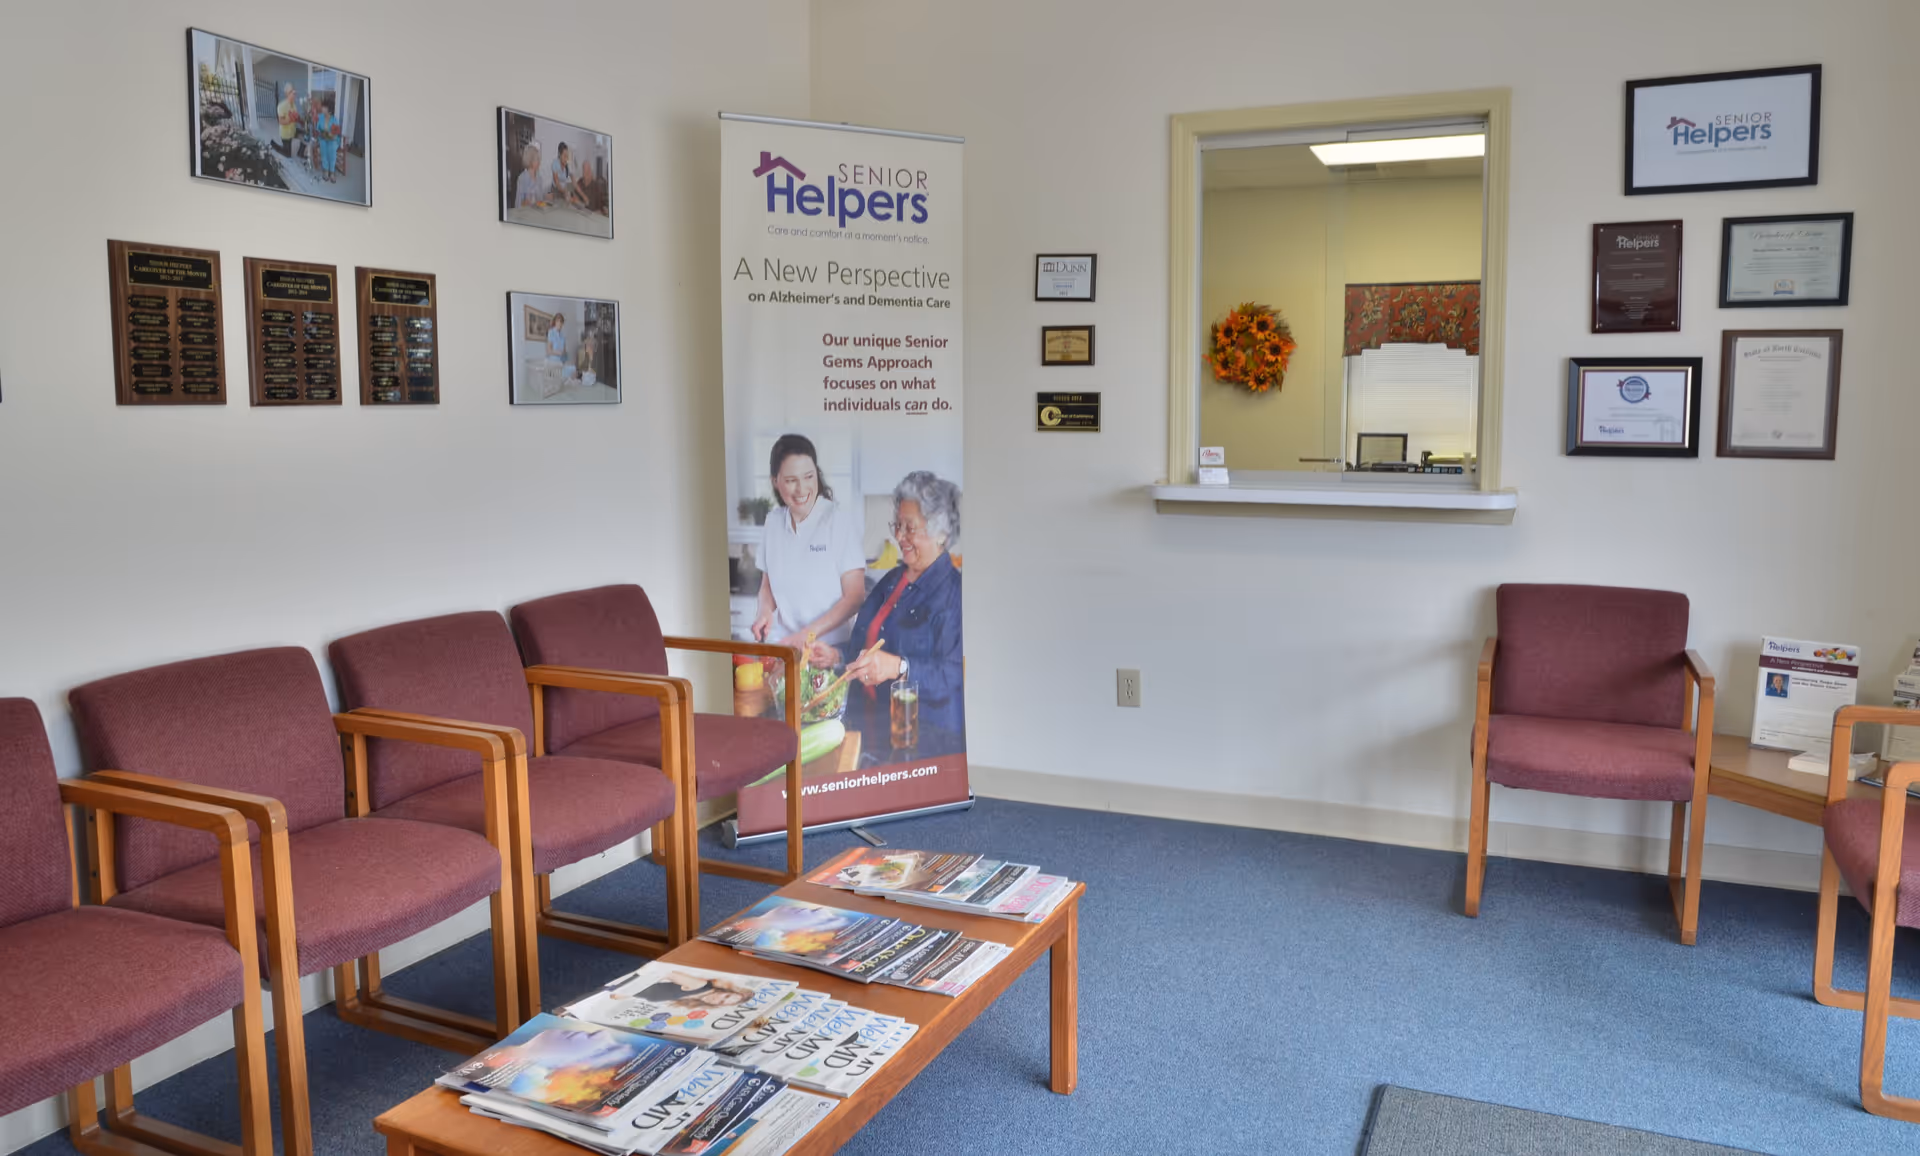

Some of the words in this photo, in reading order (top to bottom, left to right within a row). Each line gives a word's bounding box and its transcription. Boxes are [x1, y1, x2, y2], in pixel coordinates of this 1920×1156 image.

[1715, 112, 1772, 126] SENIOR
[1673, 122, 1772, 148] Helpers
[838, 163, 928, 190] SENIOR
[766, 172, 929, 228] Helpers
[767, 225, 789, 236] Care
[790, 226, 808, 237] and
[810, 228, 842, 239] comfort
[844, 231, 853, 239] at
[854, 232, 861, 240] a
[862, 233, 902, 243] moment's
[1618, 238, 1660, 250] Helpers
[733, 256, 754, 281] A
[764, 257, 818, 283] New
[827, 261, 950, 292] Perspective
[748, 292, 766, 302] on
[768, 291, 840, 305] Alzheimer's
[843, 294, 865, 306] and
[868, 295, 923, 308] Dementia
[926, 297, 951, 309] Care
[822, 333, 849, 347] Our
[853, 333, 901, 350] unique
[905, 335, 949, 348] Senior
[822, 355, 863, 368] Gems
[867, 355, 933, 372] Approach
[823, 376, 876, 390] focuses
[880, 380, 897, 390] on
[901, 376, 936, 390] what
[823, 397, 901, 411] individuals
[904, 400, 928, 411] can
[931, 397, 952, 411] do.
[711, 981, 789, 1030] WebMD
[743, 993, 820, 1044] WebMD
[761, 1002, 839, 1054] WebMD
[785, 1009, 866, 1060] WebMD
[824, 1017, 898, 1068] WebMD
[632, 1068, 724, 1130] WebMD
